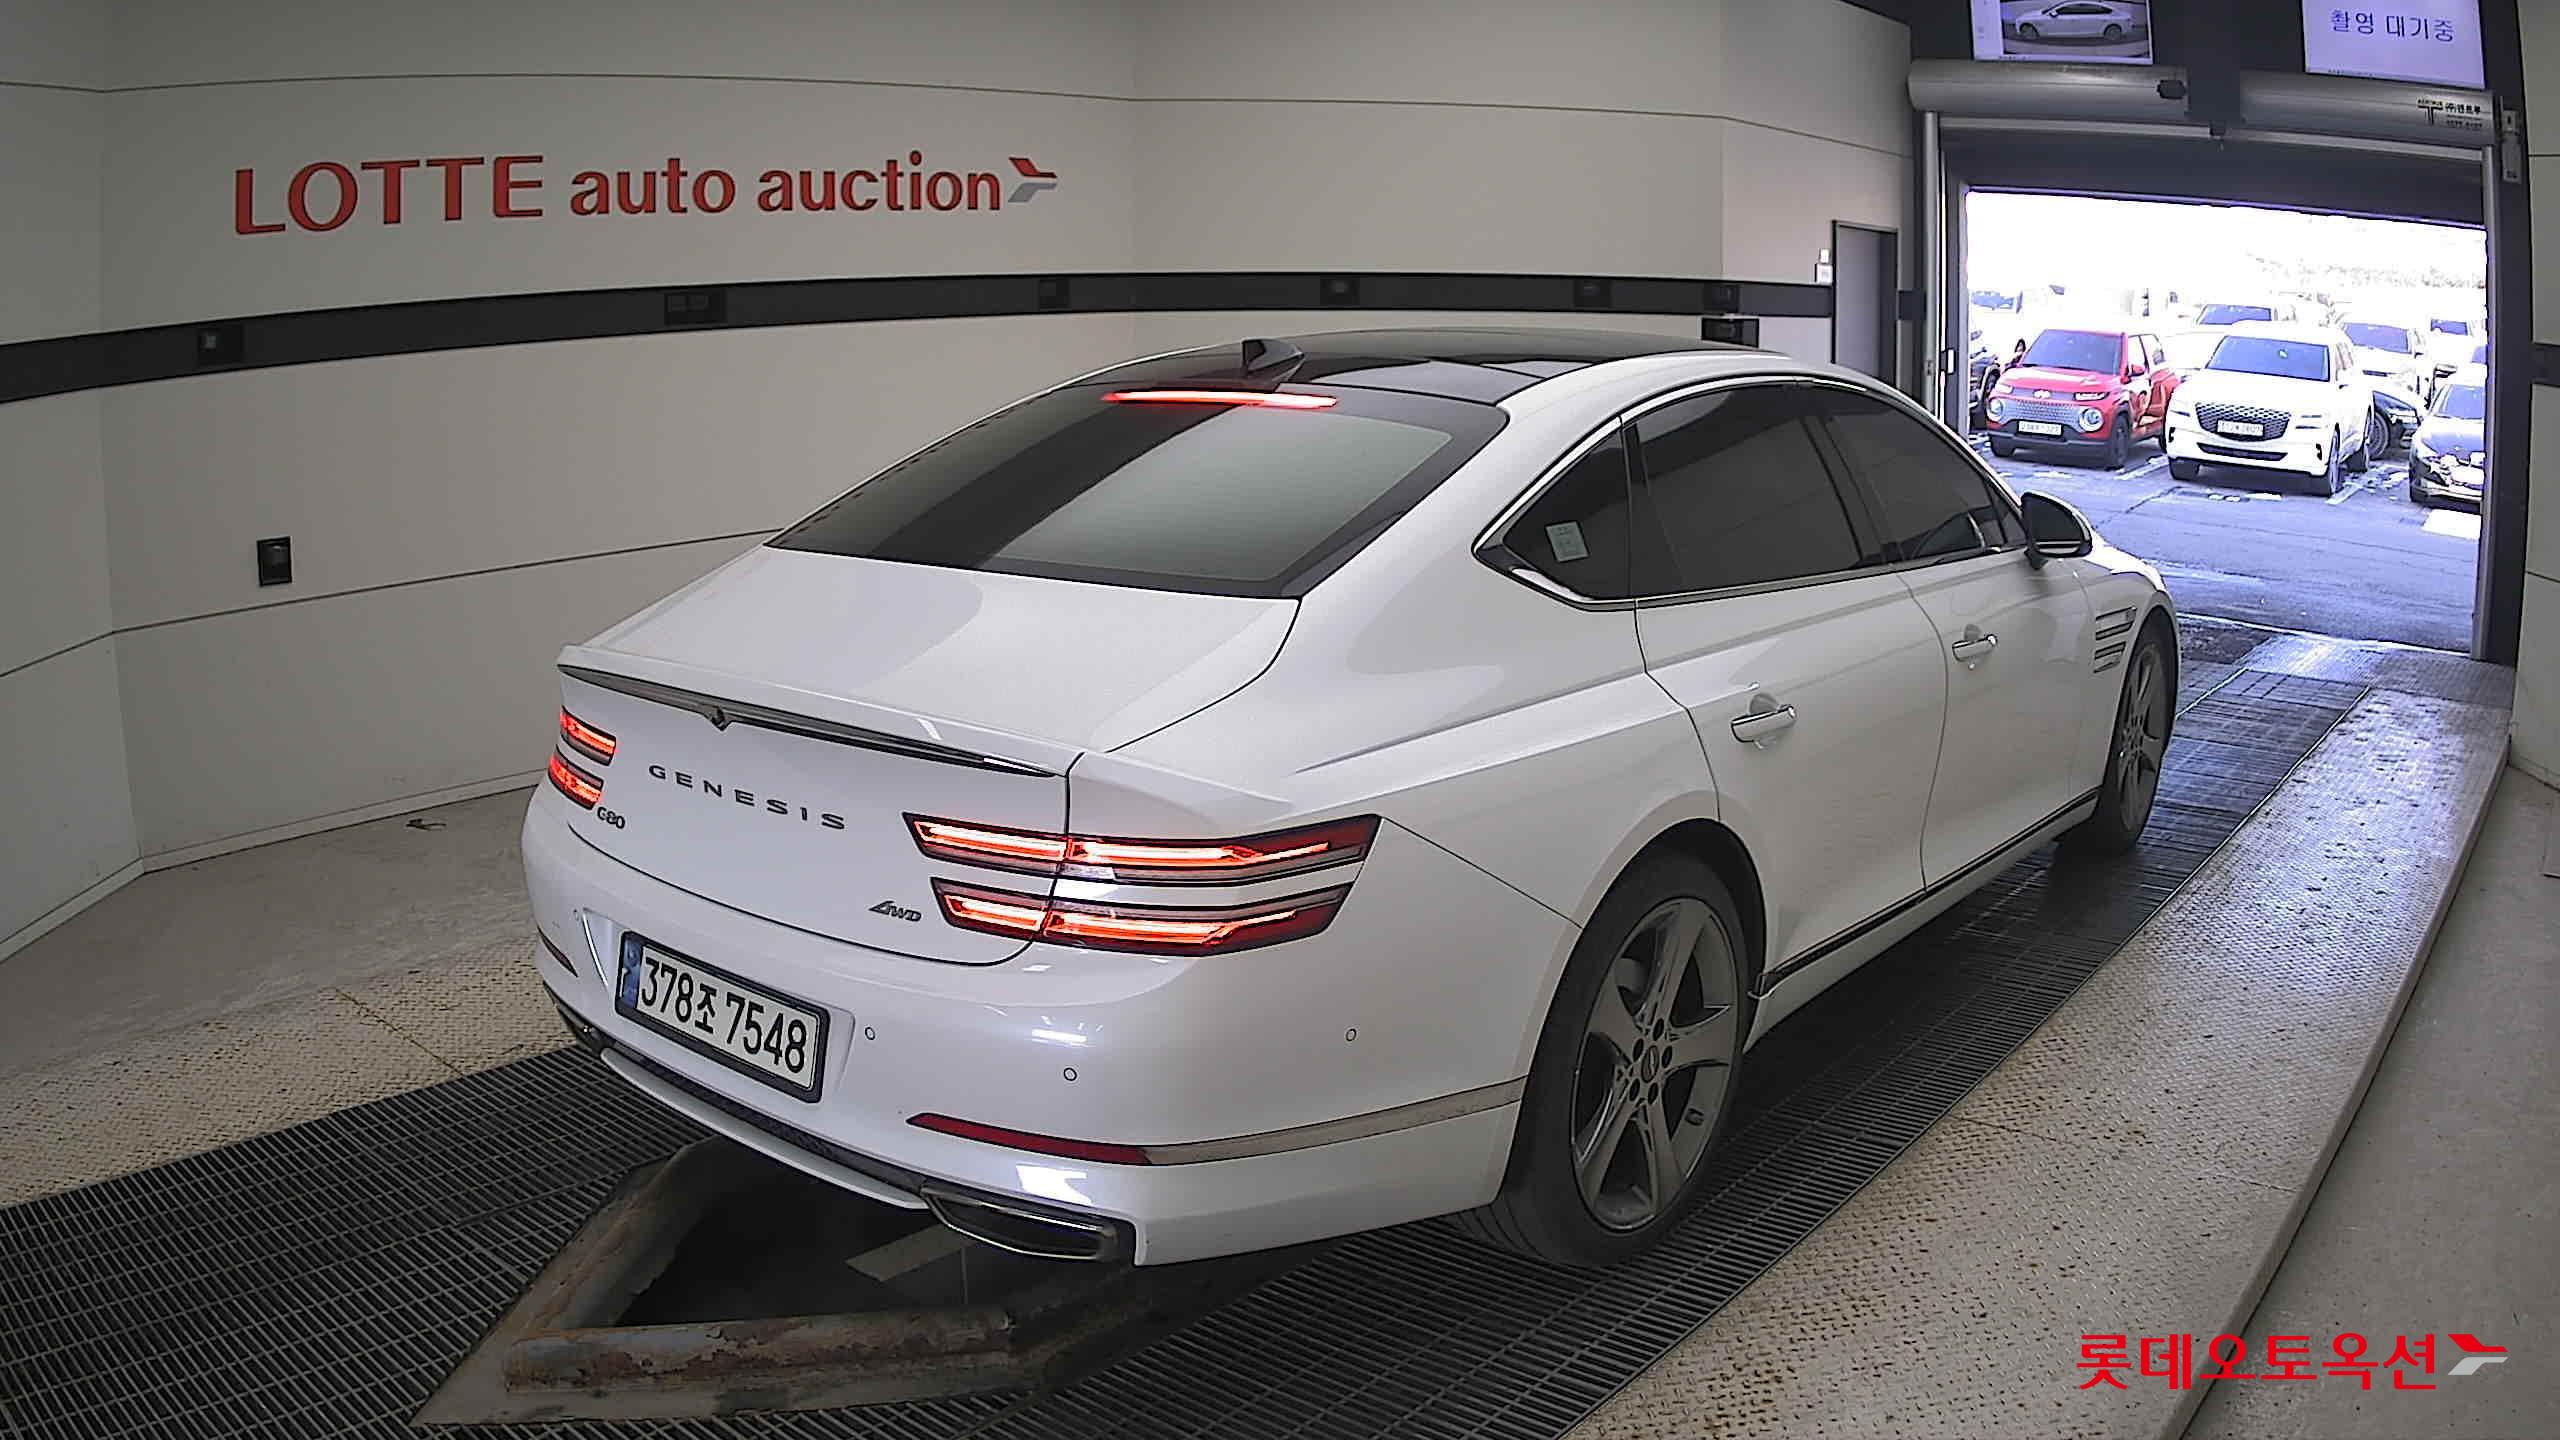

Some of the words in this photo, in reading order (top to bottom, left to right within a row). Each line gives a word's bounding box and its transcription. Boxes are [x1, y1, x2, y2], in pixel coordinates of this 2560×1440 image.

[2331, 9, 2374, 35] 촬영
[2386, 15, 2454, 42] 대기중
[235, 155, 544, 235] LOTTE
[570, 158, 736, 216] auto
[757, 150, 1000, 212] auction
[597, 806, 626, 829] G80
[649, 764, 845, 830] GENESIS
[641, 956, 718, 1035] 378조
[725, 991, 808, 1074] 7548
